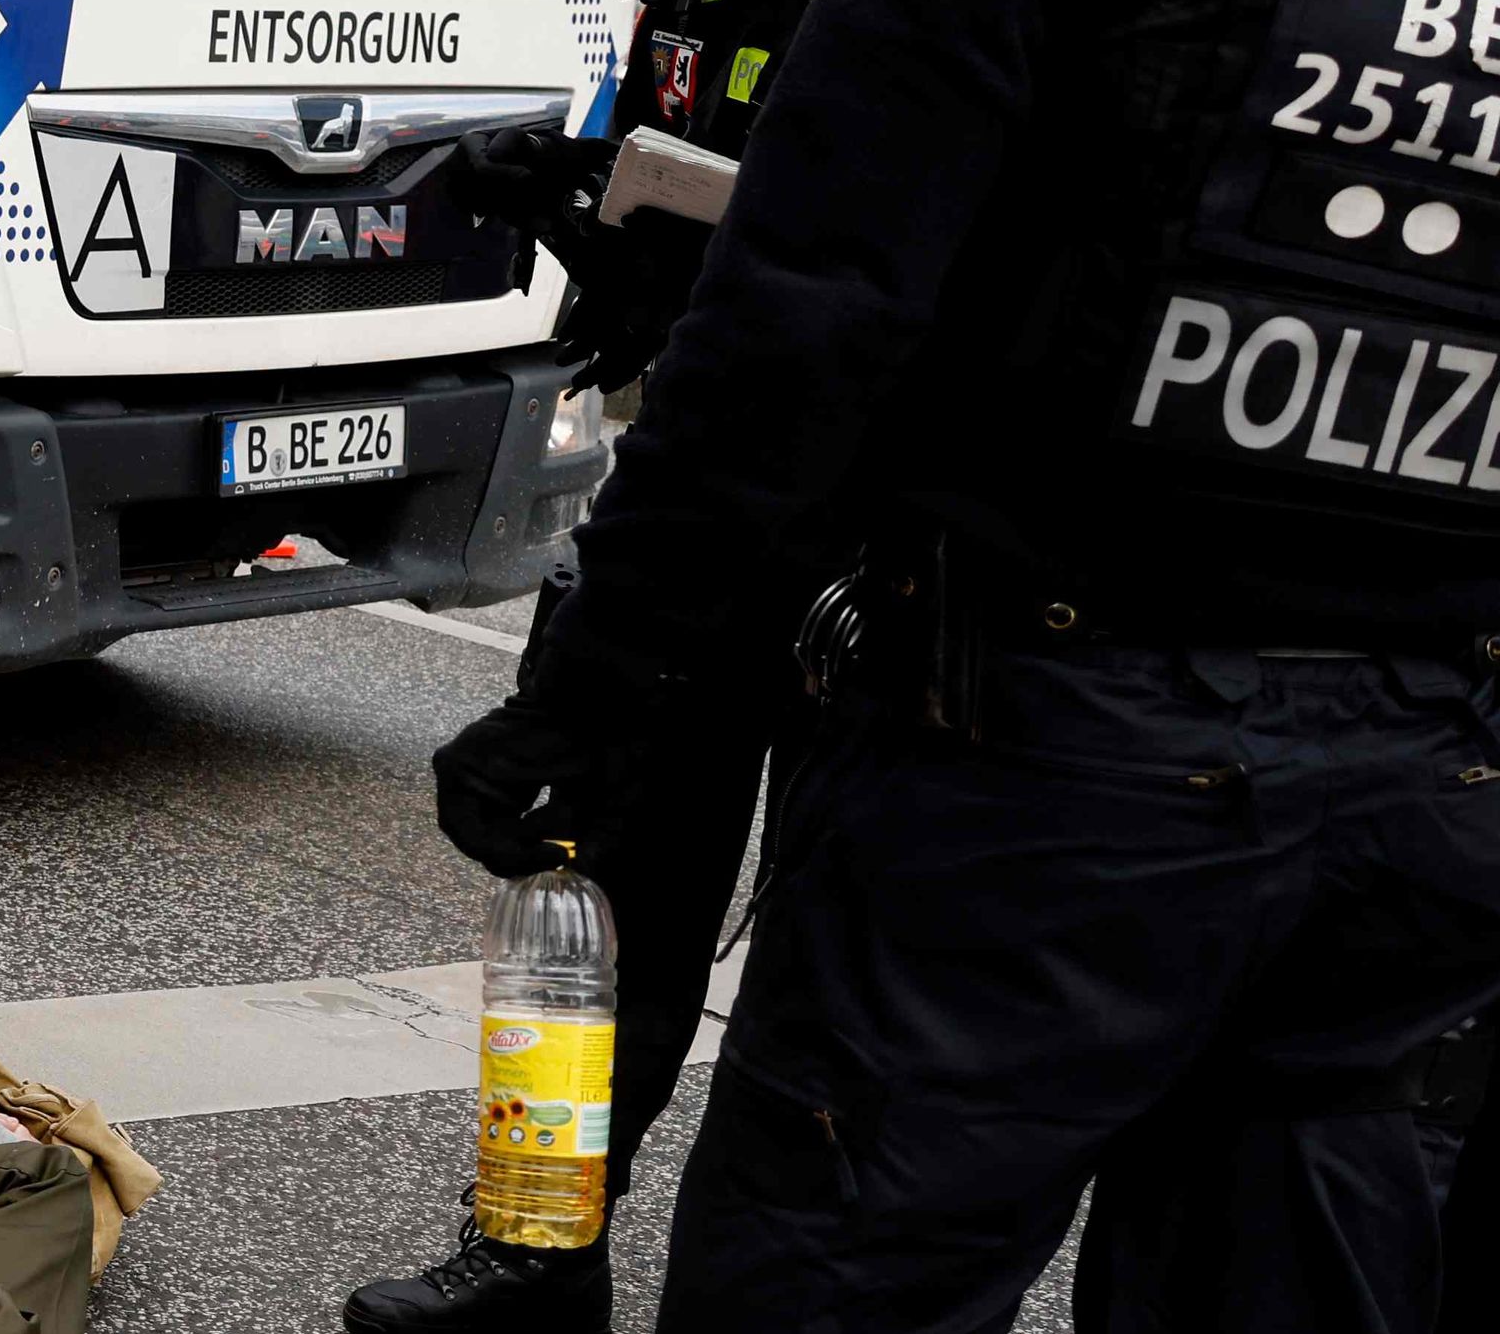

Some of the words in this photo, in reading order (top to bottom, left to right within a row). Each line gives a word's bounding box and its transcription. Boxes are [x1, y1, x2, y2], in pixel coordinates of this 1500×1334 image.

[208, 9, 461, 64] ENTSORGUNG
[69, 152, 152, 282] A
[235, 203, 408, 264] MAN
[248, 425, 268, 474] B
[290, 419, 329, 470] BE
[338, 413, 392, 465] 226
